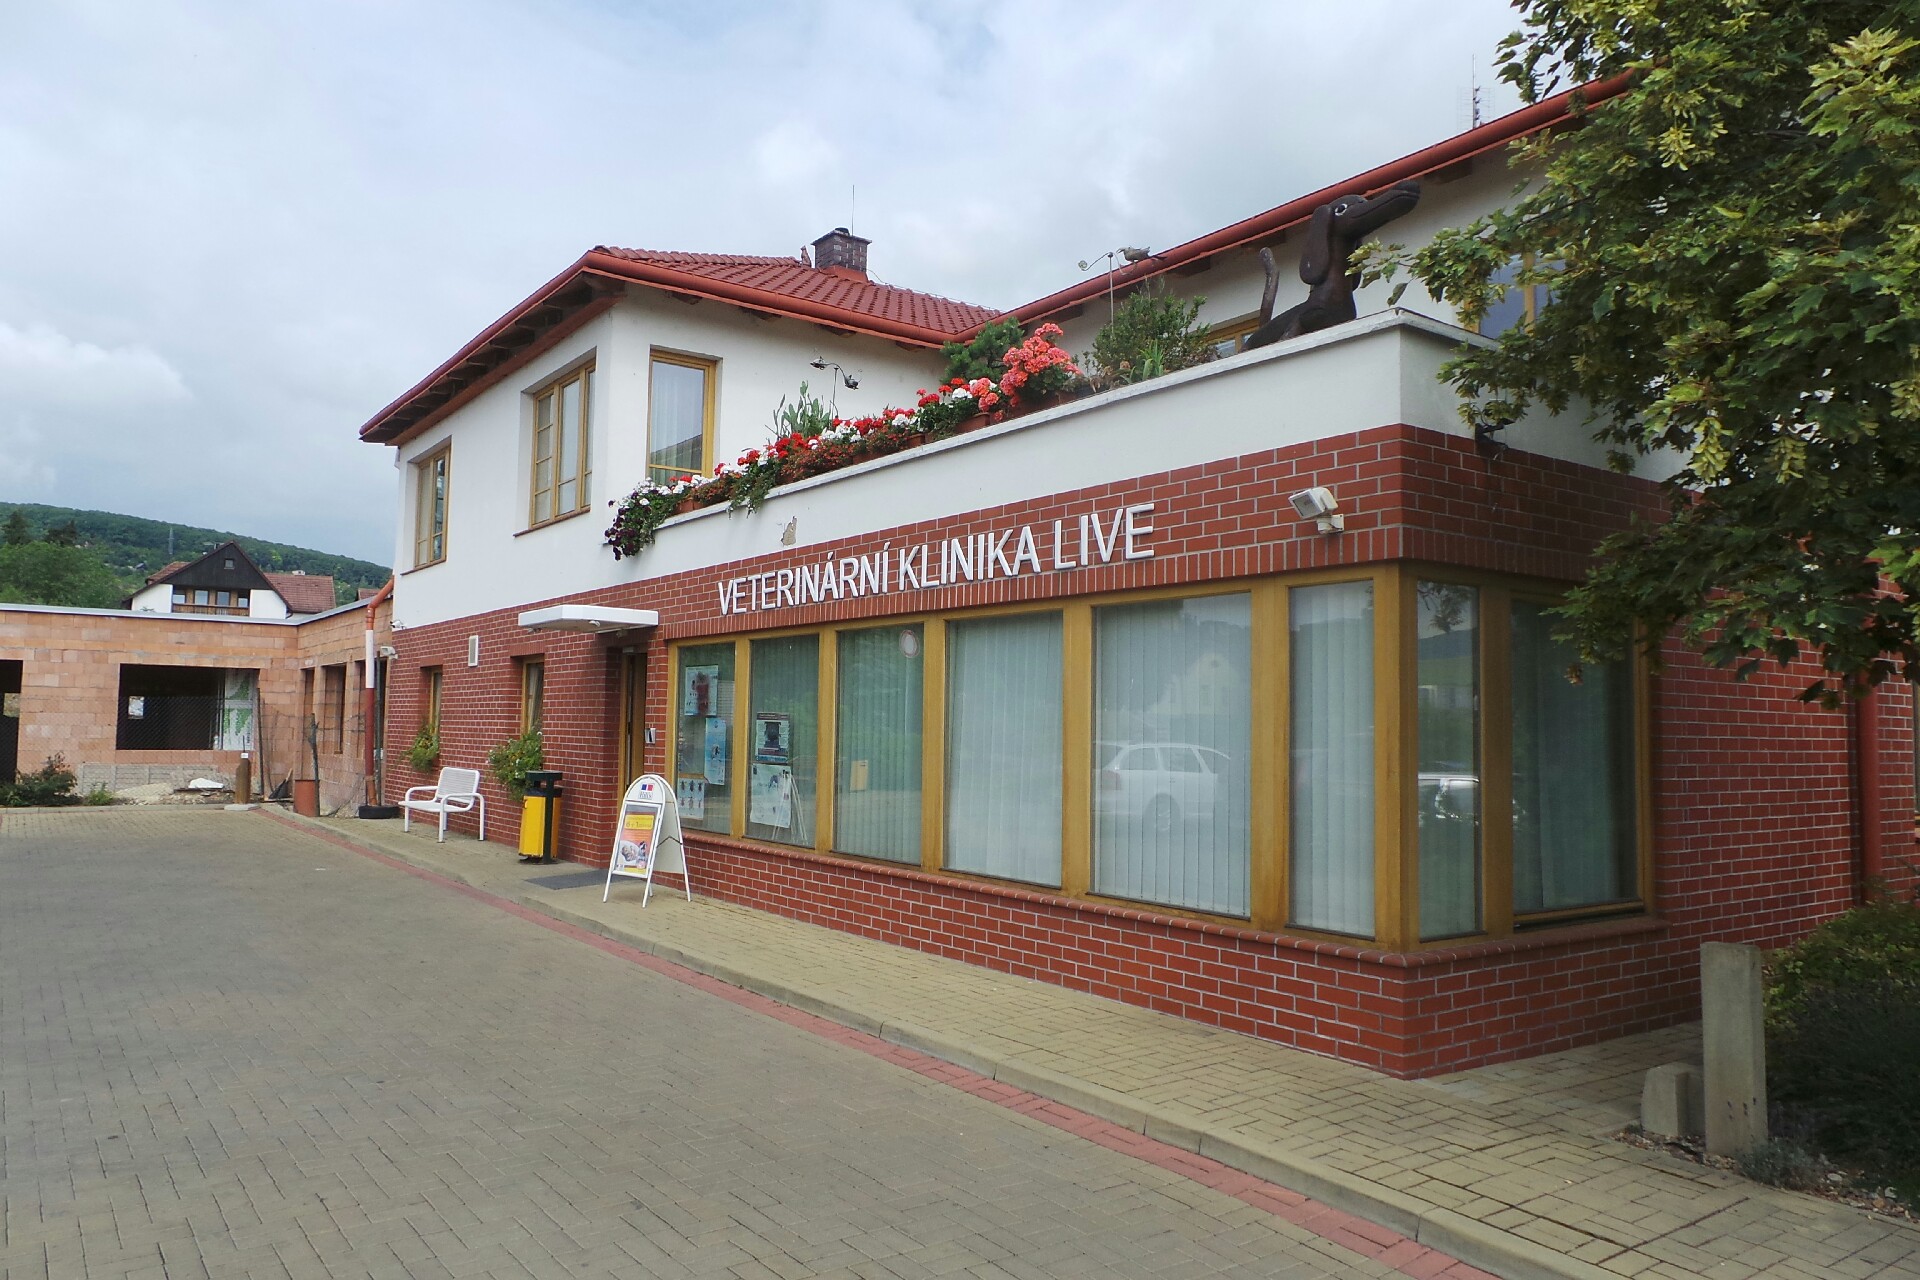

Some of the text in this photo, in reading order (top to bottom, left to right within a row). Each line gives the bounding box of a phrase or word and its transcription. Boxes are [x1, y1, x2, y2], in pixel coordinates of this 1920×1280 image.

[718, 503, 1155, 616] VETERINÁRNÍ KLINIKA LIVE
